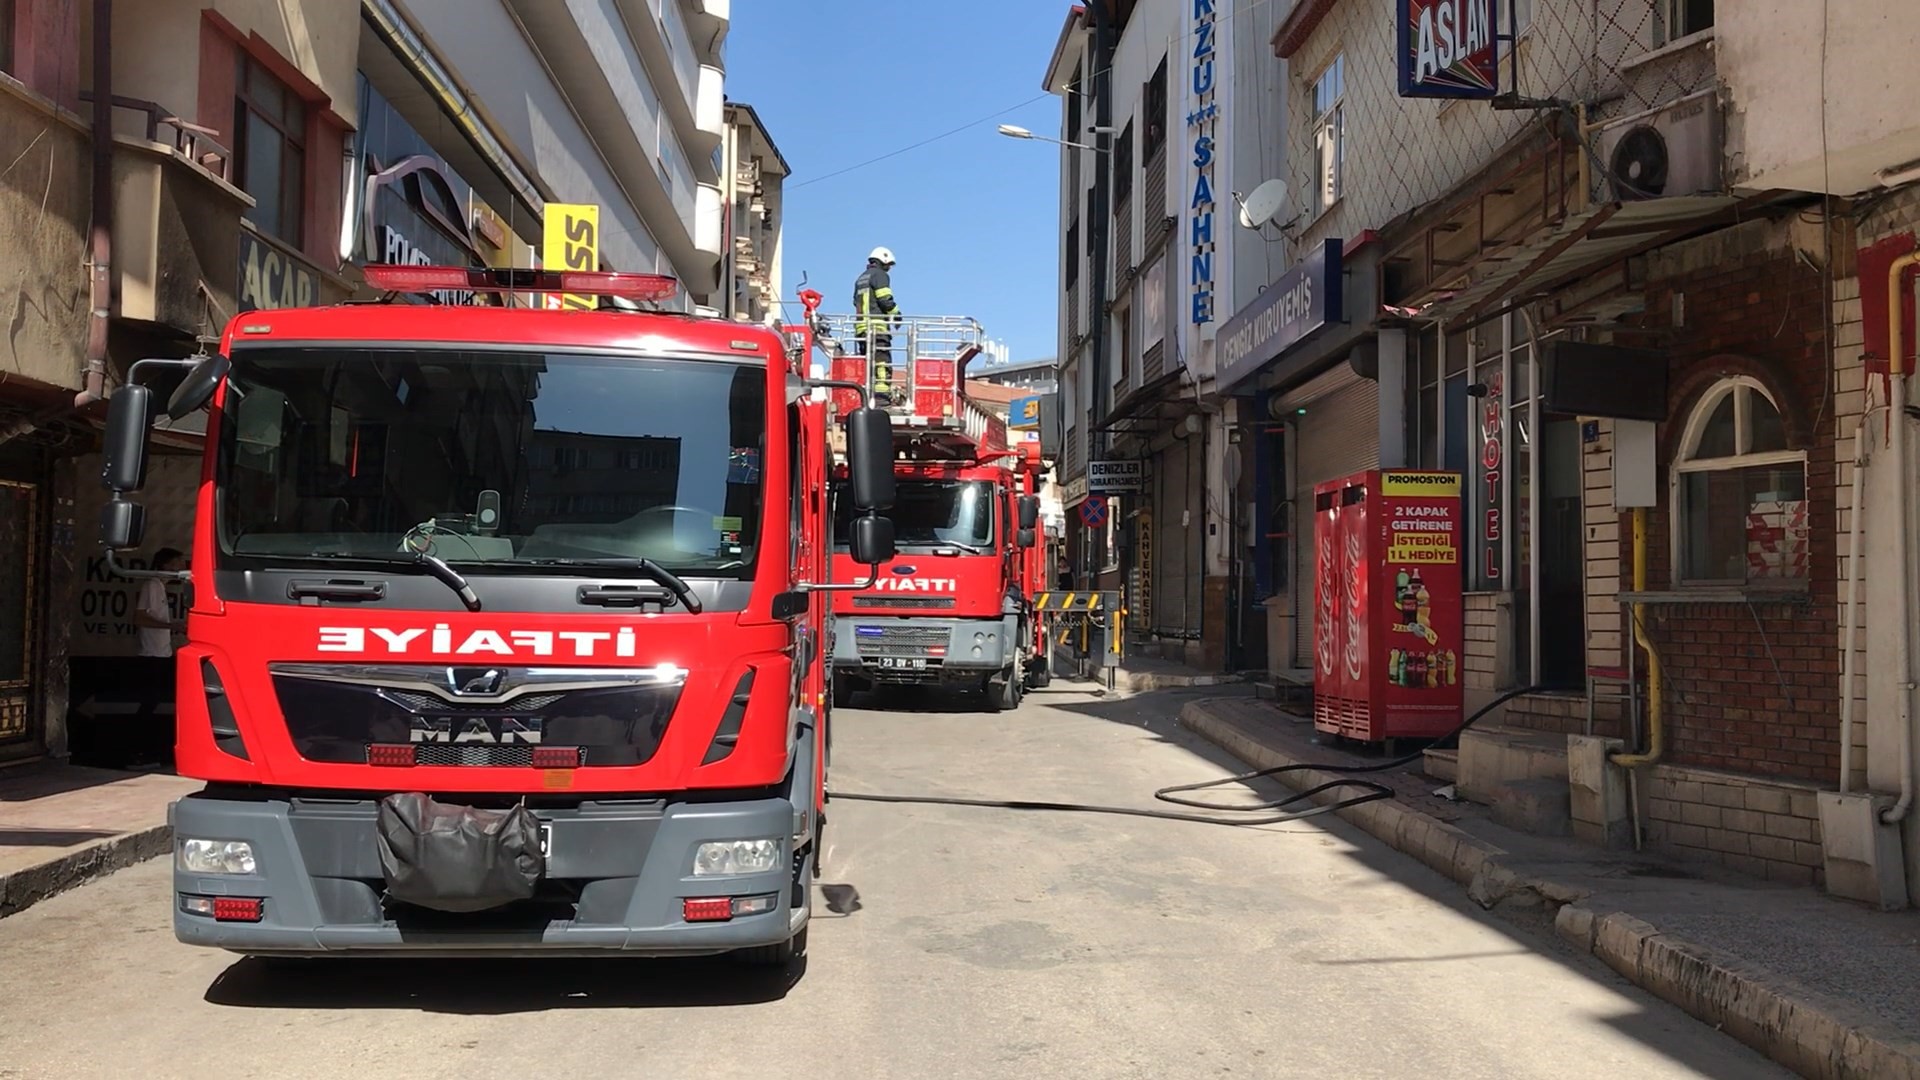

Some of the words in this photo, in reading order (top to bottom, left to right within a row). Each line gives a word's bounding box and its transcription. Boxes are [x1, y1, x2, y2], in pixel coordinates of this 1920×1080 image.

[1415, 0, 1489, 83] ASLAN
[1191, 136, 1213, 324] SAHNE
[1254, 271, 1312, 347] KURUYEMİŞ
[1388, 475, 1456, 484] PROMOSYON
[1483, 402, 1502, 579] HOTEL
[1395, 506, 1403, 516] 2
[1406, 507, 1449, 517] KAPAK
[1391, 518, 1453, 530] GETİRENE
[1396, 534, 1449, 546] İSTEDİĞİ
[1390, 550, 1395, 560] 1
[1399, 550, 1406, 560] L
[1409, 548, 1455, 560] HEDİYE
[81, 588, 128, 618] OTO
[1344, 528, 1361, 681] Coca-Cola
[84, 621, 107, 635] VE
[883, 657, 893, 667] 23
[408, 716, 543, 744] MAN
